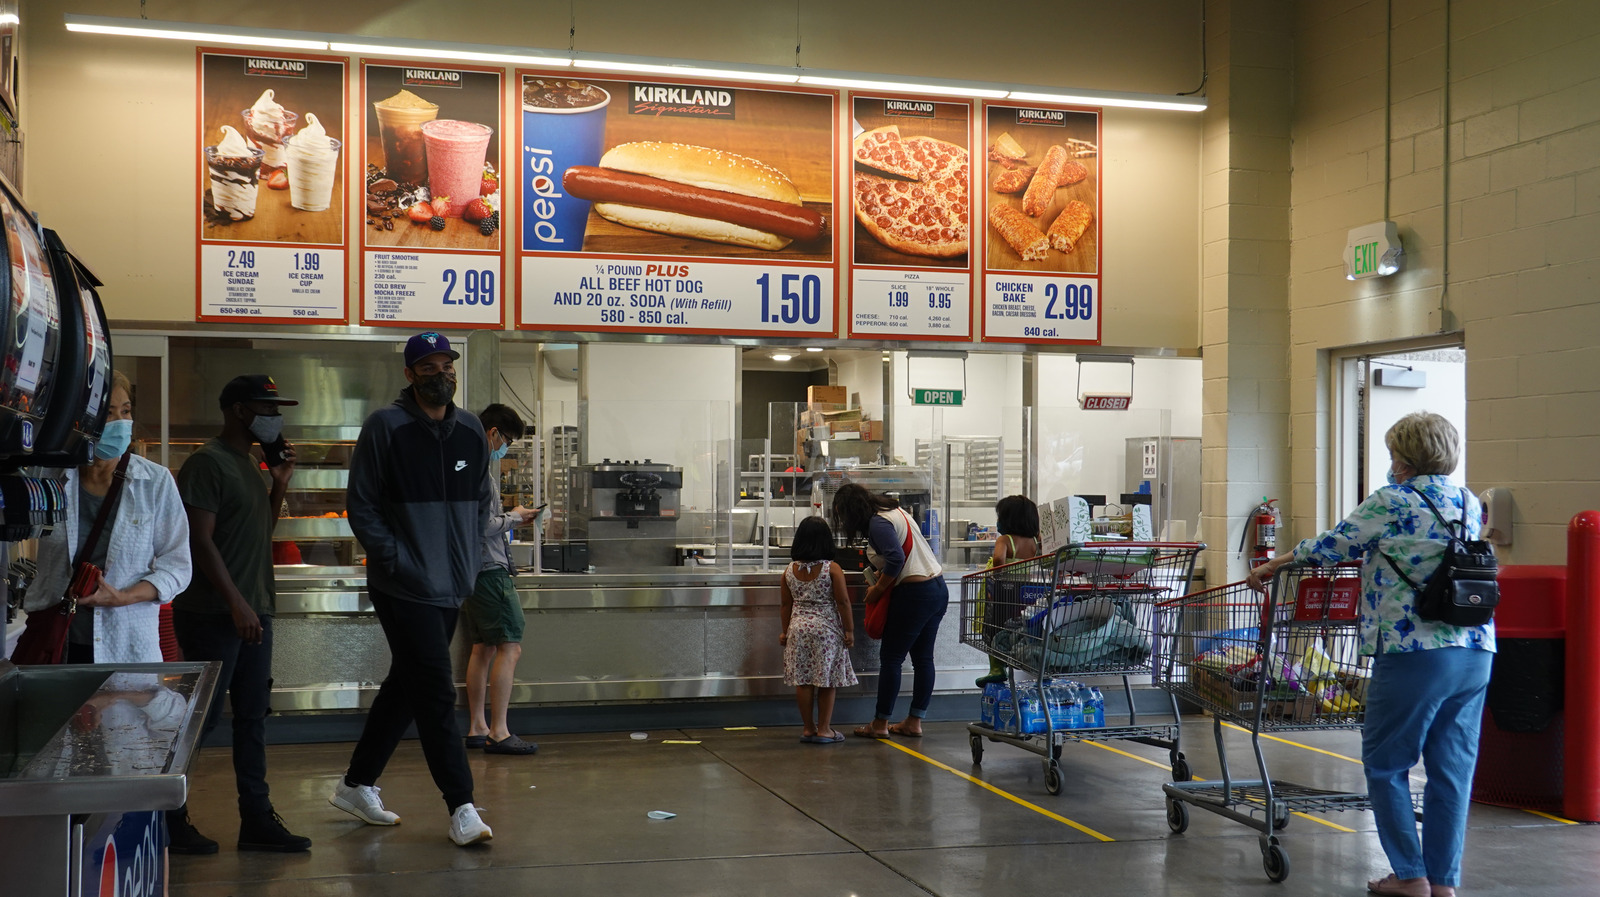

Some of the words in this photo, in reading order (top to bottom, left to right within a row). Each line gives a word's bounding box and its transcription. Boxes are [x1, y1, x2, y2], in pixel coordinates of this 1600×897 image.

[248, 58, 304, 72] KIRKLAND
[406, 69, 460, 82] KIRKLAND
[634, 86, 731, 107] KIRKLAND
[634, 101, 731, 117] Signature
[887, 101, 933, 112] KIRKLAND
[1019, 110, 1063, 120] KIRKLAND
[525, 146, 564, 243] pepsi
[228, 250, 255, 268] 2.49
[294, 252, 320, 270] 1.99
[1355, 242, 1378, 274] EXIT
[608, 265, 642, 276] POUND
[646, 265, 689, 278] PLUS
[442, 269, 494, 306] 2.99
[579, 277, 604, 290] ALL
[609, 278, 640, 292] BEEF
[645, 279, 671, 293] HOT
[676, 280, 703, 294] DOG
[996, 282, 1033, 292] CHICKEN
[554, 292, 582, 306] AND
[586, 293, 602, 306] 20
[607, 296, 625, 307] oz.
[630, 294, 666, 308] SODA
[670, 298, 698, 310] (With
[700, 298, 732, 312] Refill)
[756, 273, 821, 324] 1.50
[888, 292, 909, 307] 1.99
[929, 292, 951, 308] 9.95
[1003, 293, 1026, 302] BAKE
[1045, 283, 1092, 320] 2.99
[601, 309, 625, 322] 580
[638, 310, 661, 324] 850
[666, 312, 688, 324] cal.
[1024, 327, 1040, 336] 840
[1042, 328, 1059, 337] cal.
[924, 391, 954, 404] OPEN
[1086, 398, 1127, 409] CLOSED
